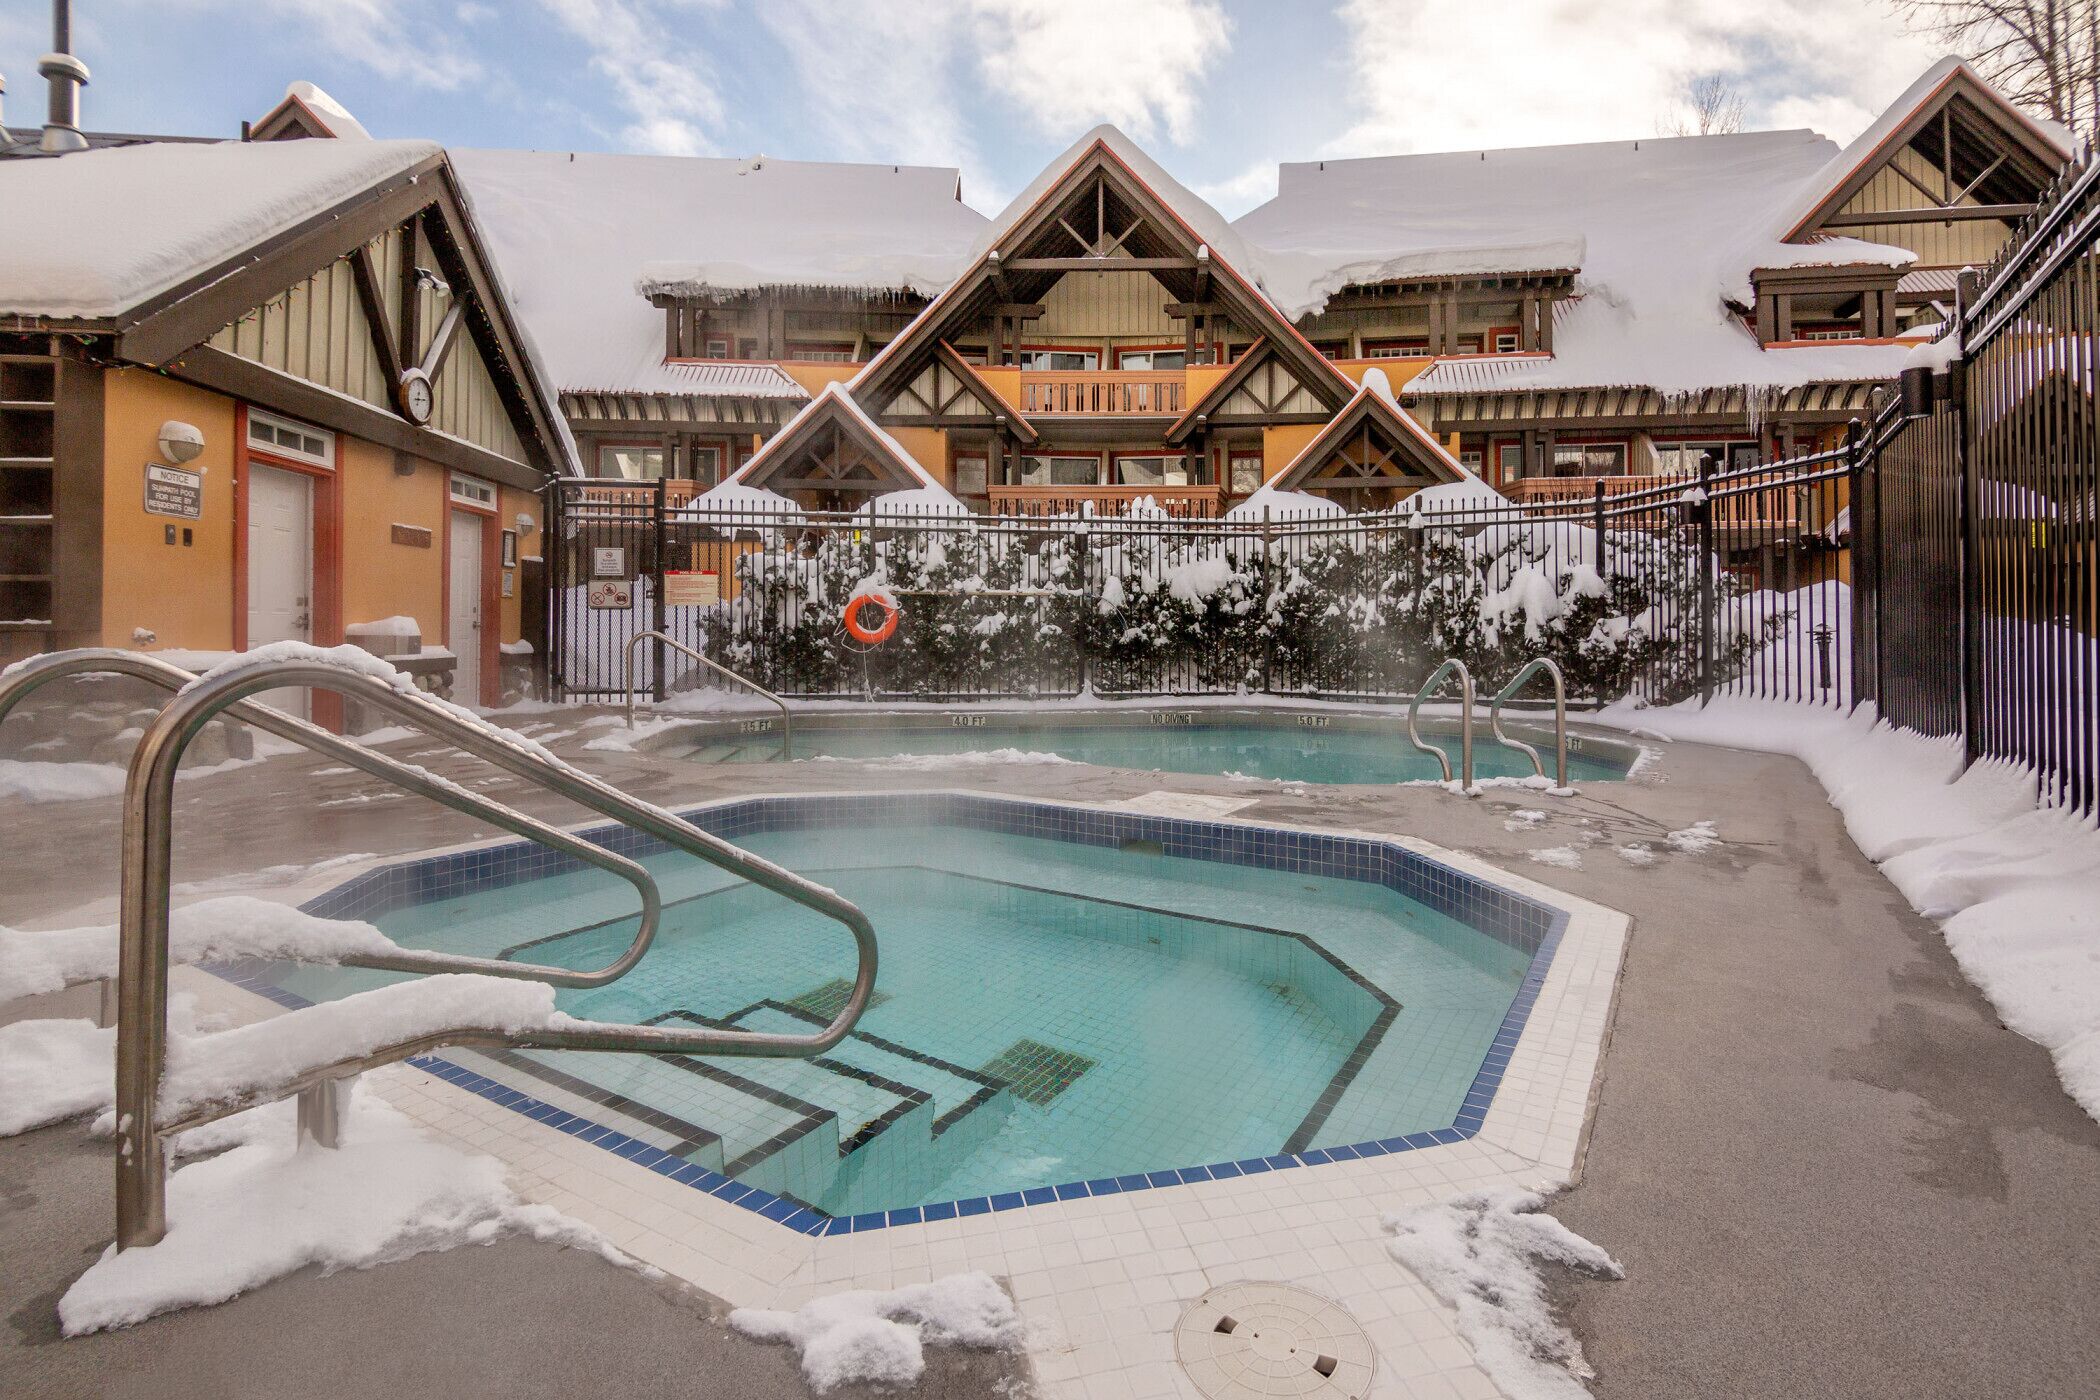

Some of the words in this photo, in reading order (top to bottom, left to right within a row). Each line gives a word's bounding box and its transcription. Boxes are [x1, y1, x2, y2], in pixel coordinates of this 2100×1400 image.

[160, 471, 189, 485] NOTICE
[155, 492, 169, 501] FOR
[170, 495, 182, 504] USE
[180, 489, 196, 498] POOL
[148, 500, 182, 511] RESIDENTS
[183, 505, 199, 514] ONLY
[954, 716, 969, 726] 4.0
[972, 716, 985, 727] FT.
[1152, 714, 1163, 724] NO
[1165, 714, 1190, 724] DIVING
[1299, 715, 1313, 726] 5.0
